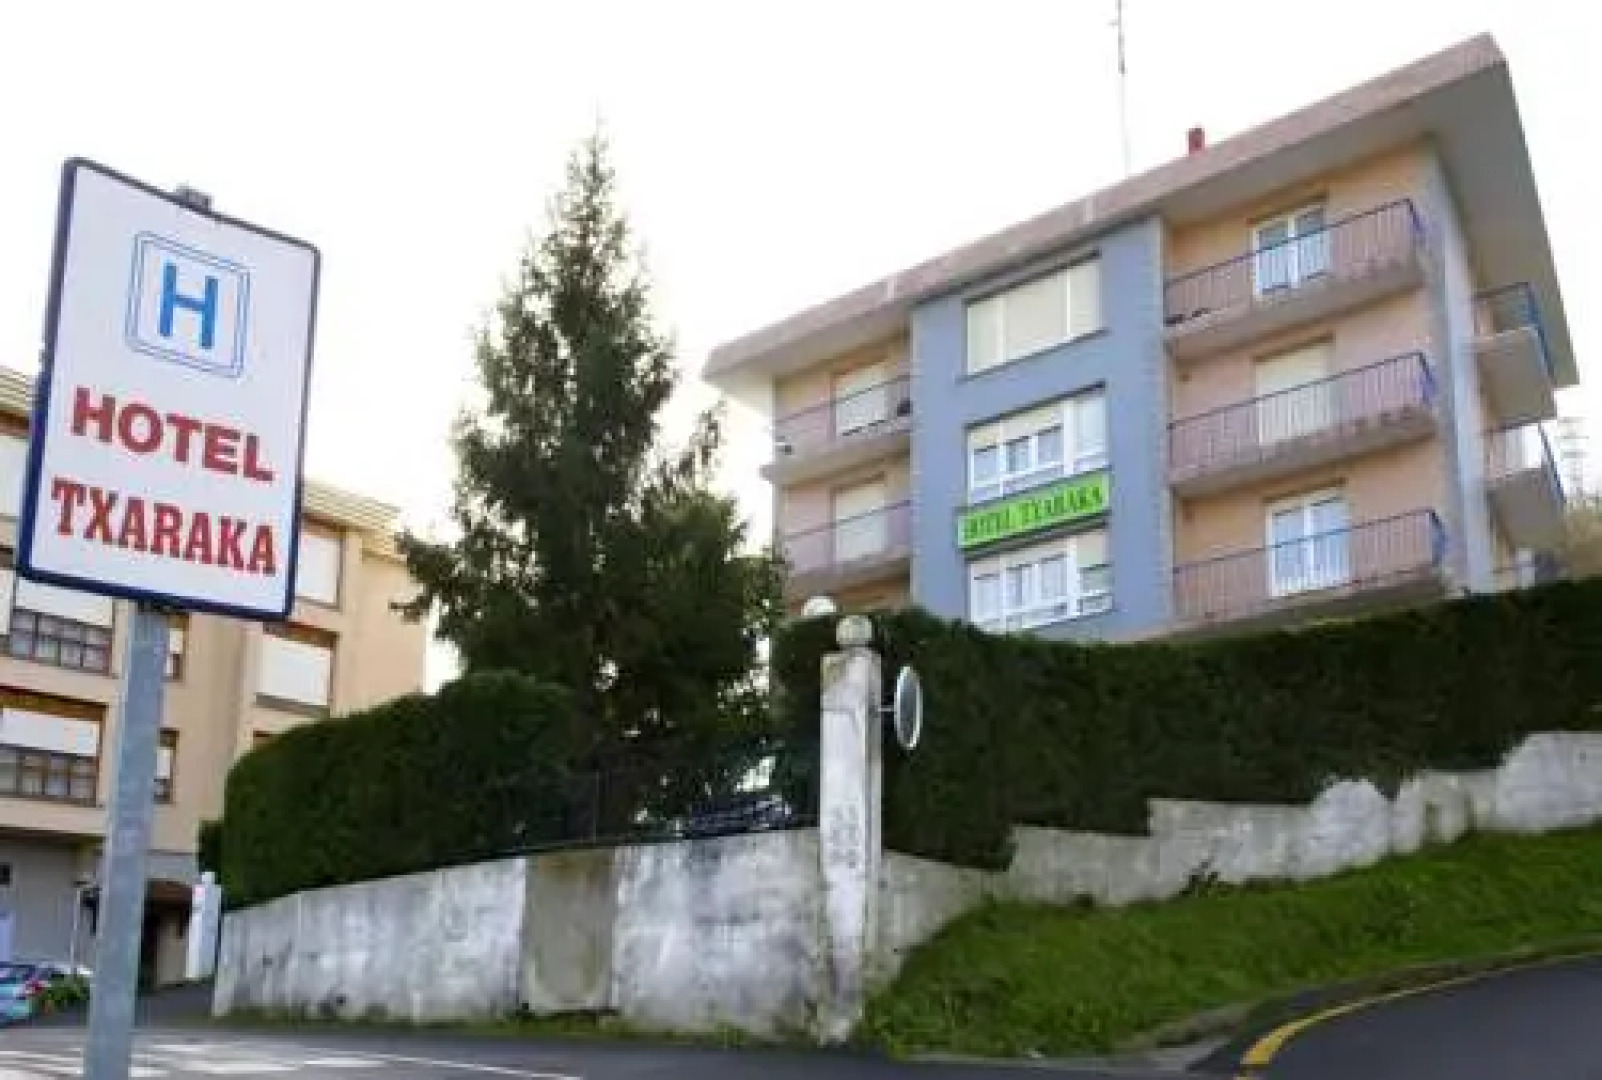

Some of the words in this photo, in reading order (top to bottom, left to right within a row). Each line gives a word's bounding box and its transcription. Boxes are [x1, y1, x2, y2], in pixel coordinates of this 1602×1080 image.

[159, 263, 218, 349] H
[72, 387, 273, 480] HOTEL
[52, 478, 276, 575] TXARAKA
